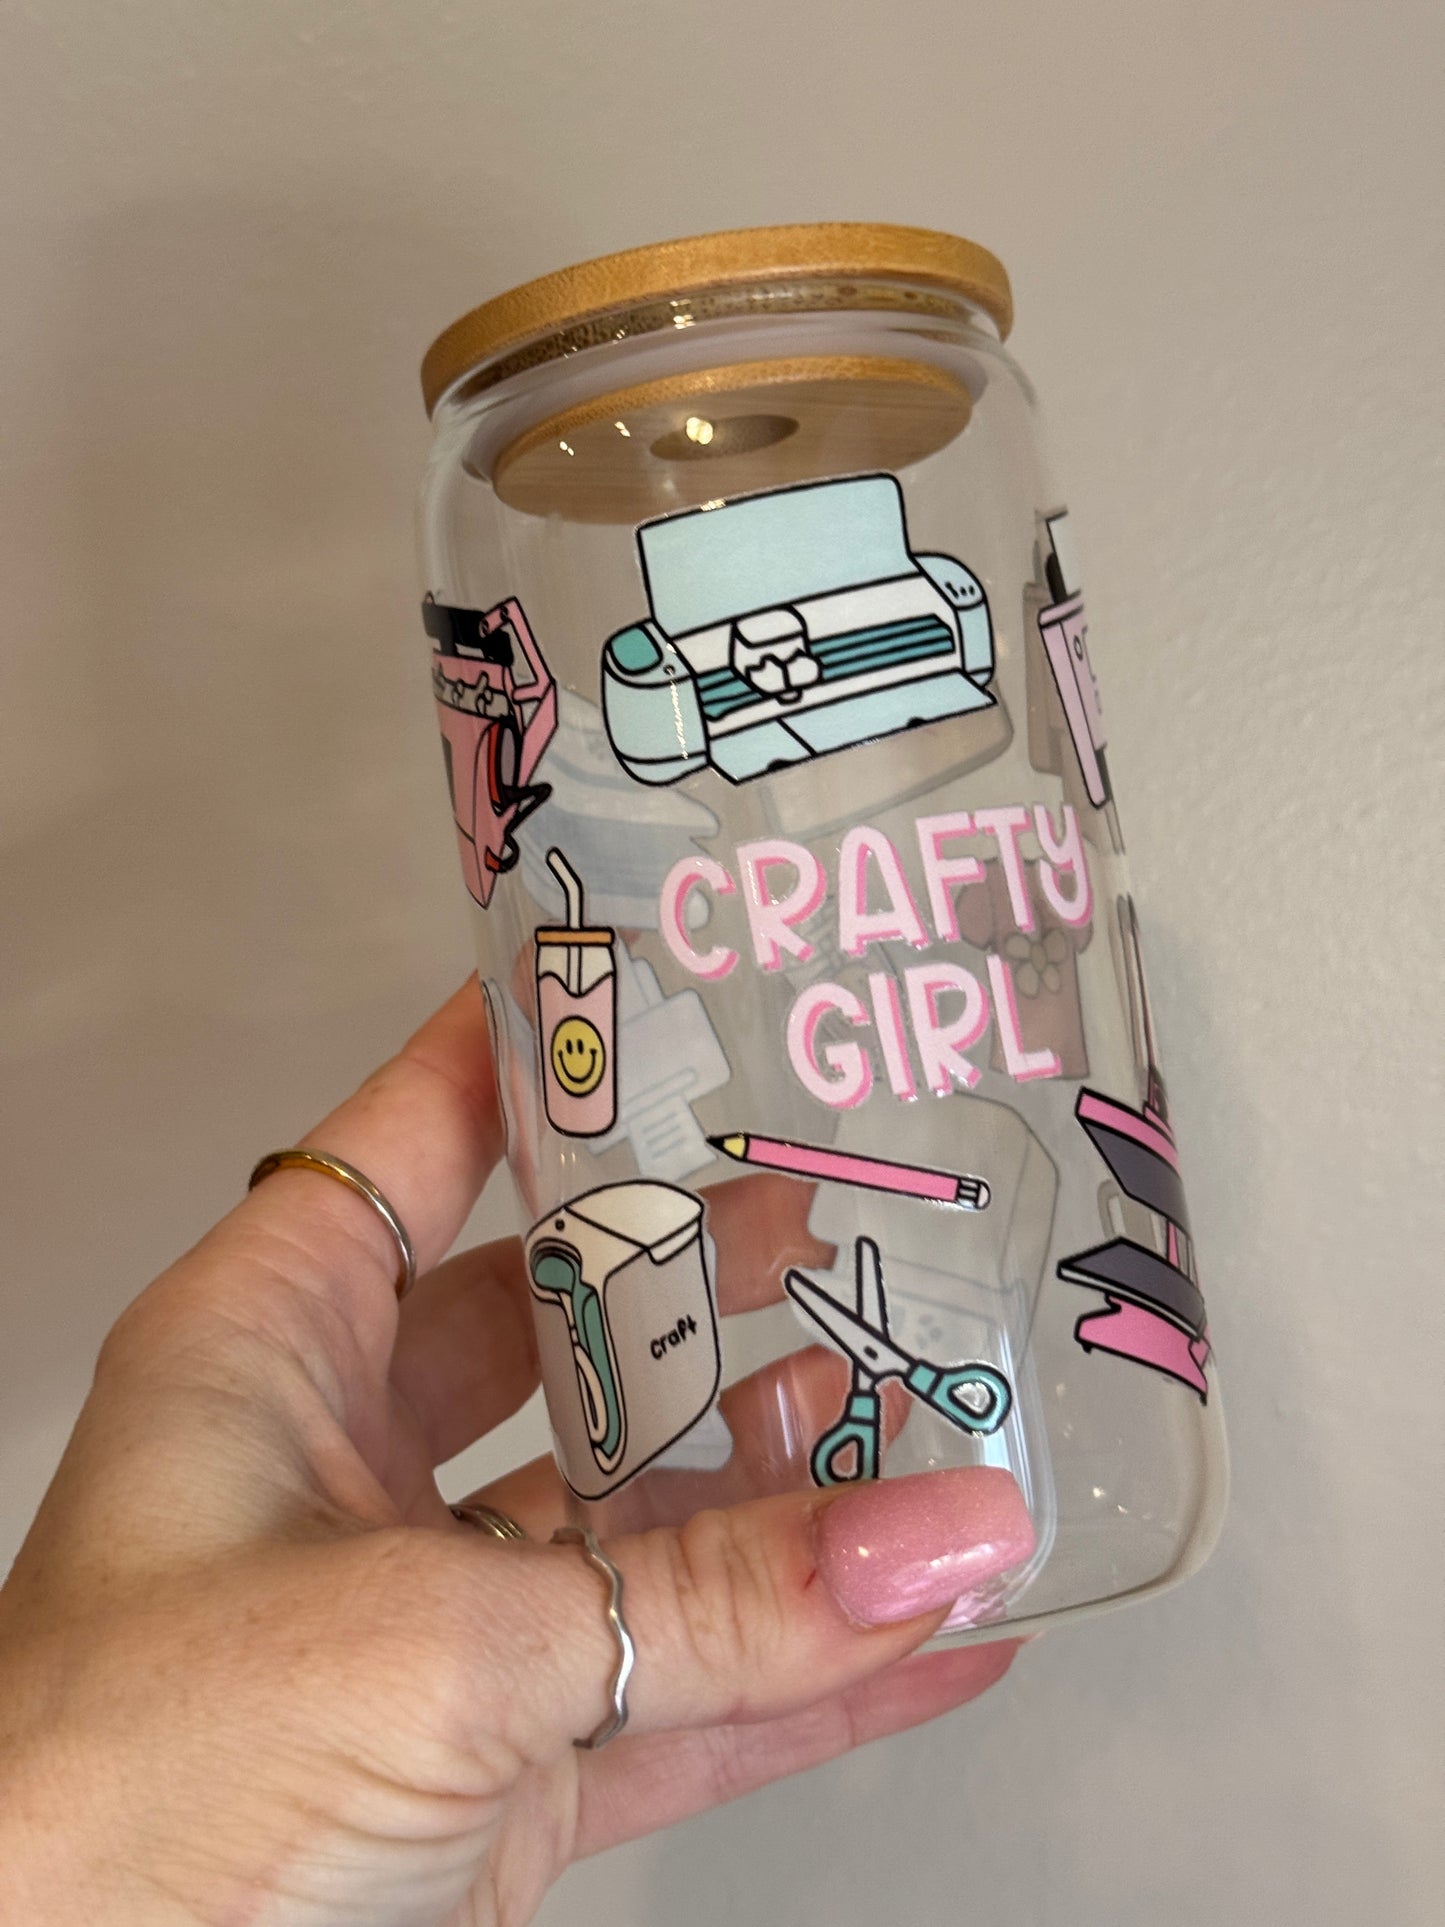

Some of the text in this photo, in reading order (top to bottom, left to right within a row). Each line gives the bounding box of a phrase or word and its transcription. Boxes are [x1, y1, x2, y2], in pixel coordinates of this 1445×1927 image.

[659, 804, 1094, 982] CRAFTY
[786, 954, 1062, 1110] GIRL
[650, 1313, 697, 1360] craft
